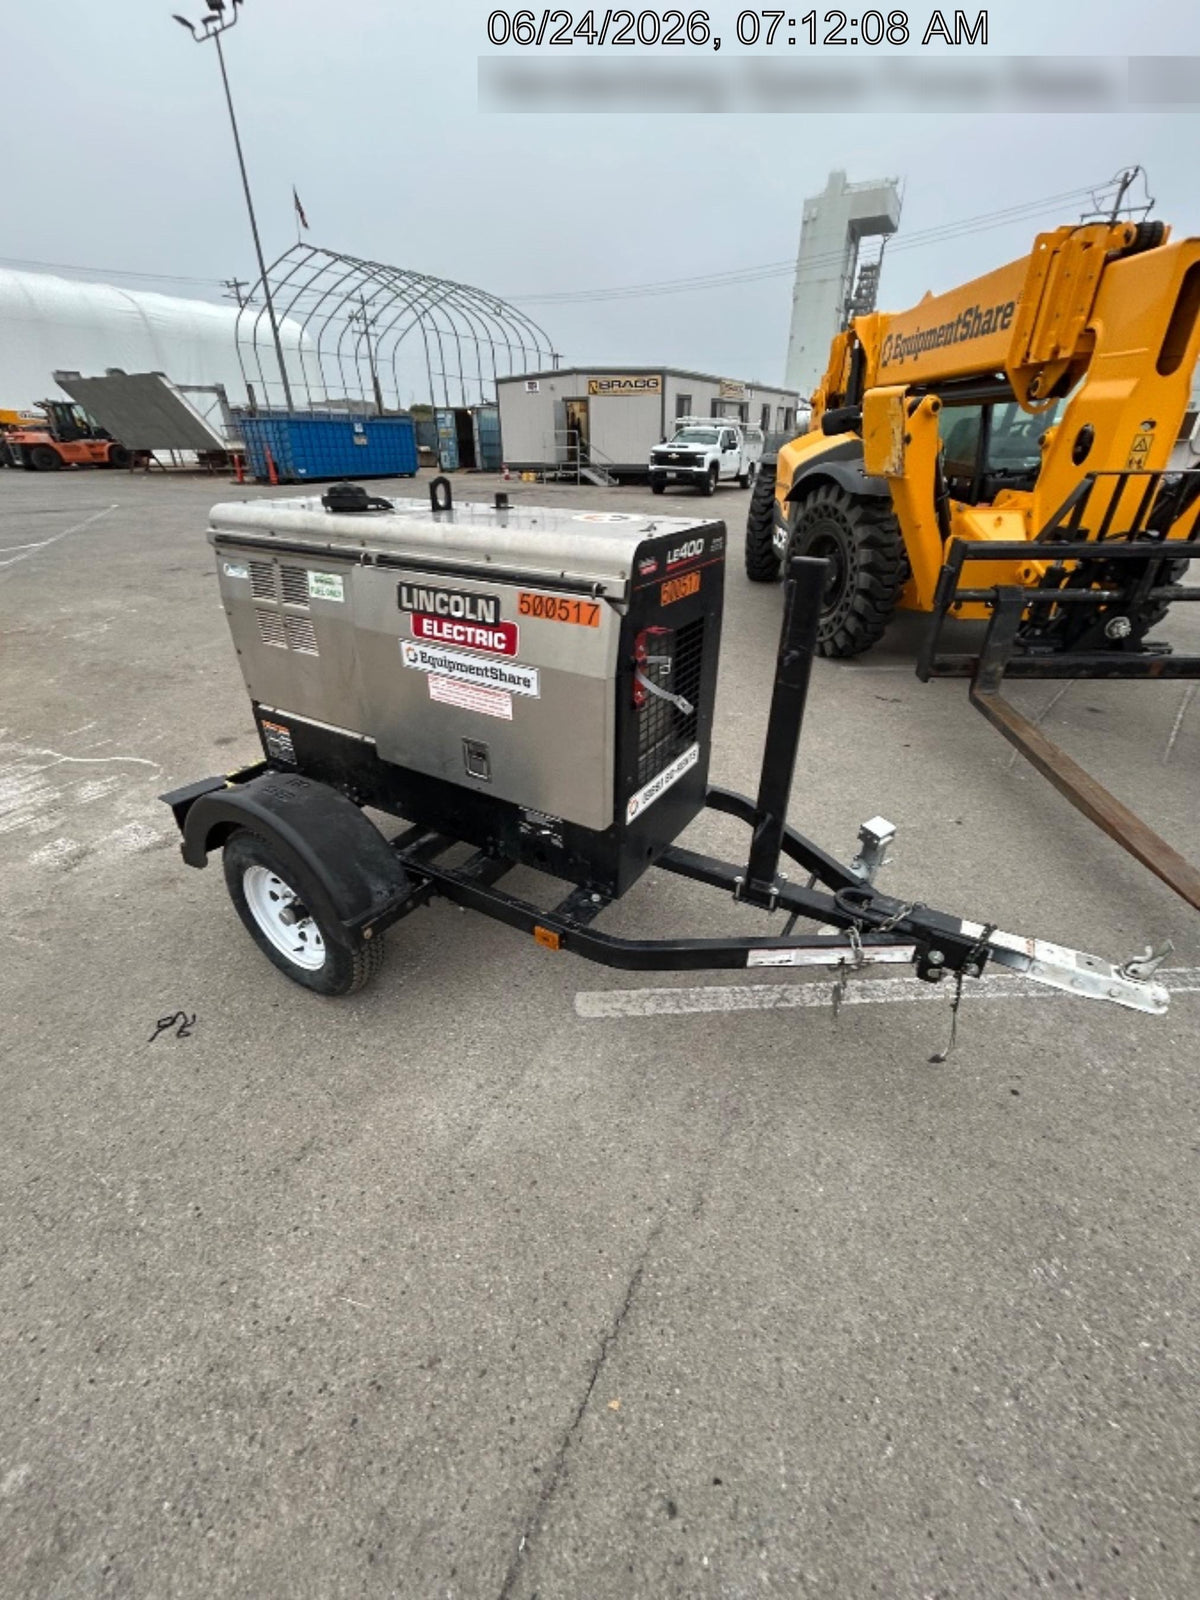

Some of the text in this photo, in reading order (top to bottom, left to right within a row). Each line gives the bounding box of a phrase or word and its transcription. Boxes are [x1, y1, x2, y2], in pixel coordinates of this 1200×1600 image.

[892, 301, 1015, 365] EquipmentShare
[401, 586, 495, 623] LINCOLN
[519, 593, 600, 624] 500517
[422, 618, 506, 650] ELECTRIC
[420, 650, 531, 689] EquipmentShare
